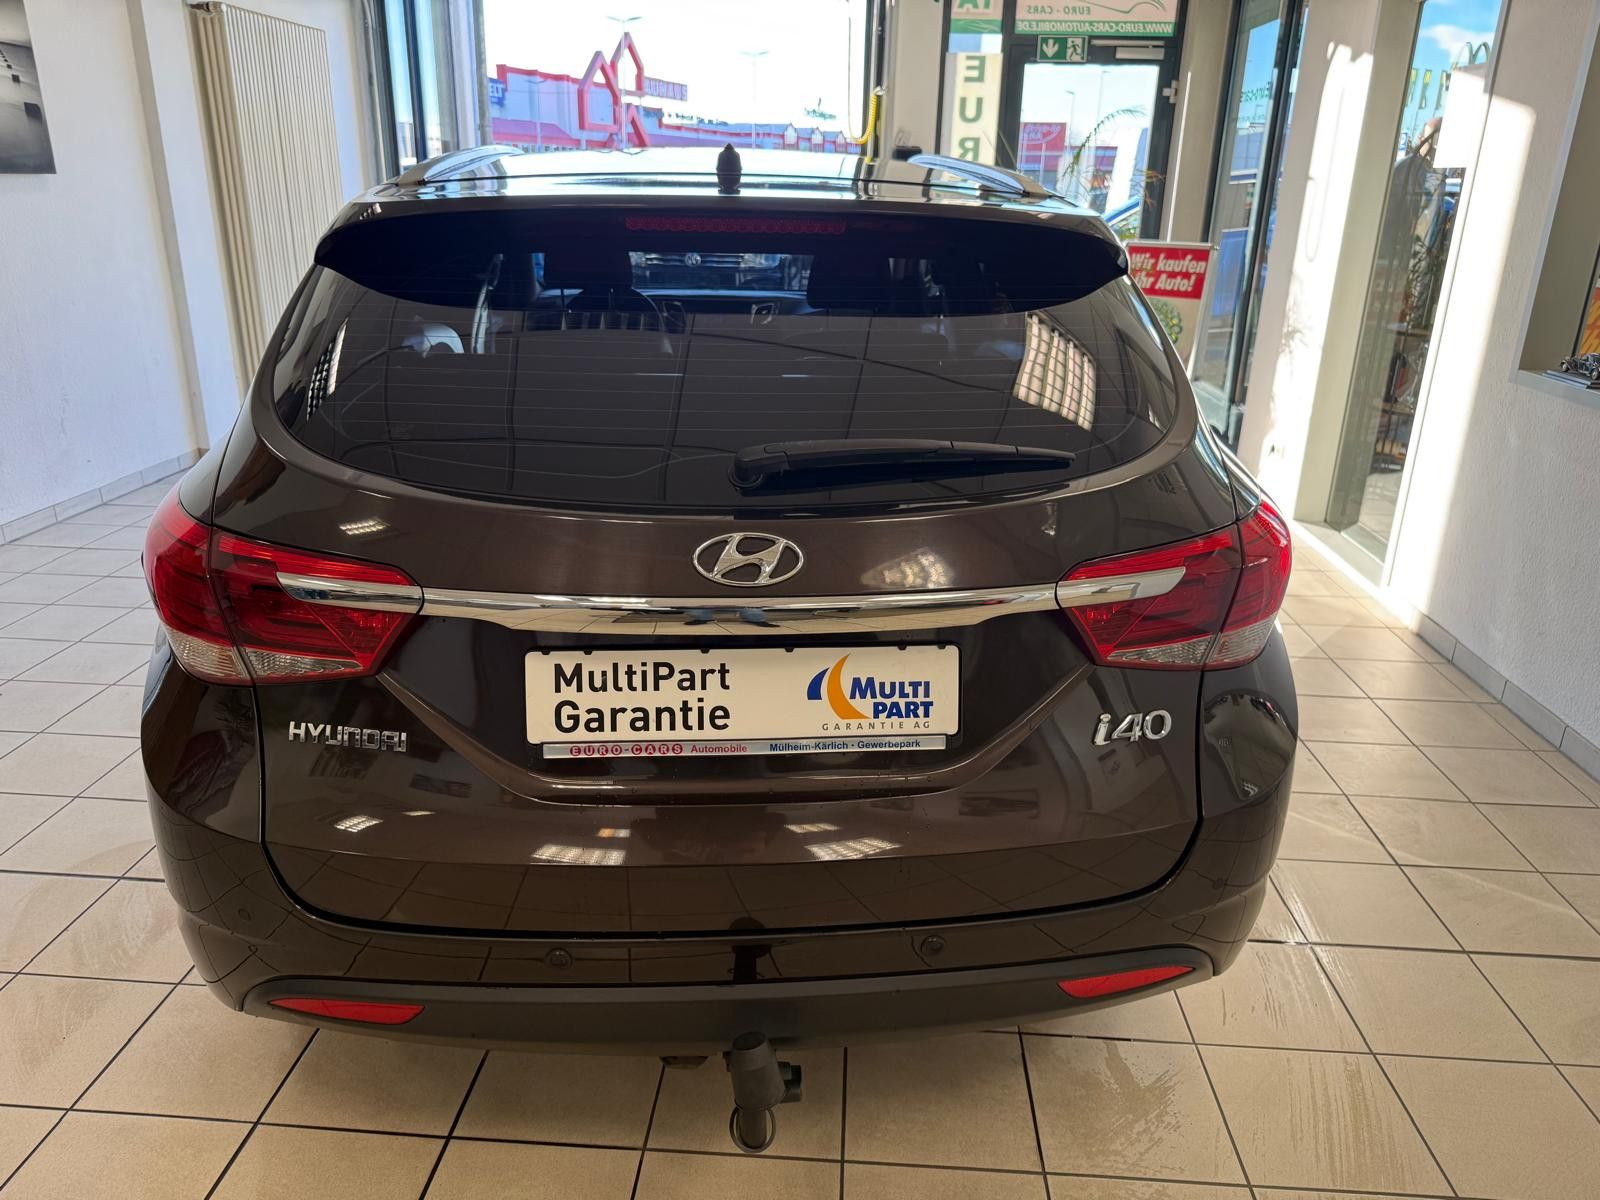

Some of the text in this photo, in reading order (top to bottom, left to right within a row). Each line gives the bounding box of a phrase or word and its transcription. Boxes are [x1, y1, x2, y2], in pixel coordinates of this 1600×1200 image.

[1131, 252, 1207, 274] Wir kaufen
[1154, 273, 1197, 292] Auto!
[554, 661, 731, 694] MultiPart
[554, 697, 731, 734] Garantie
[872, 701, 934, 719] PART
[821, 721, 931, 731] GARANTIE AG
[1094, 709, 1172, 746] i40
[288, 721, 407, 753] HYUNDAI
[769, 740, 849, 752] Mülheim-Kärlich
[857, 740, 921, 750] Gewerbepark
[570, 744, 748, 756] EURO-CARS Automobile
